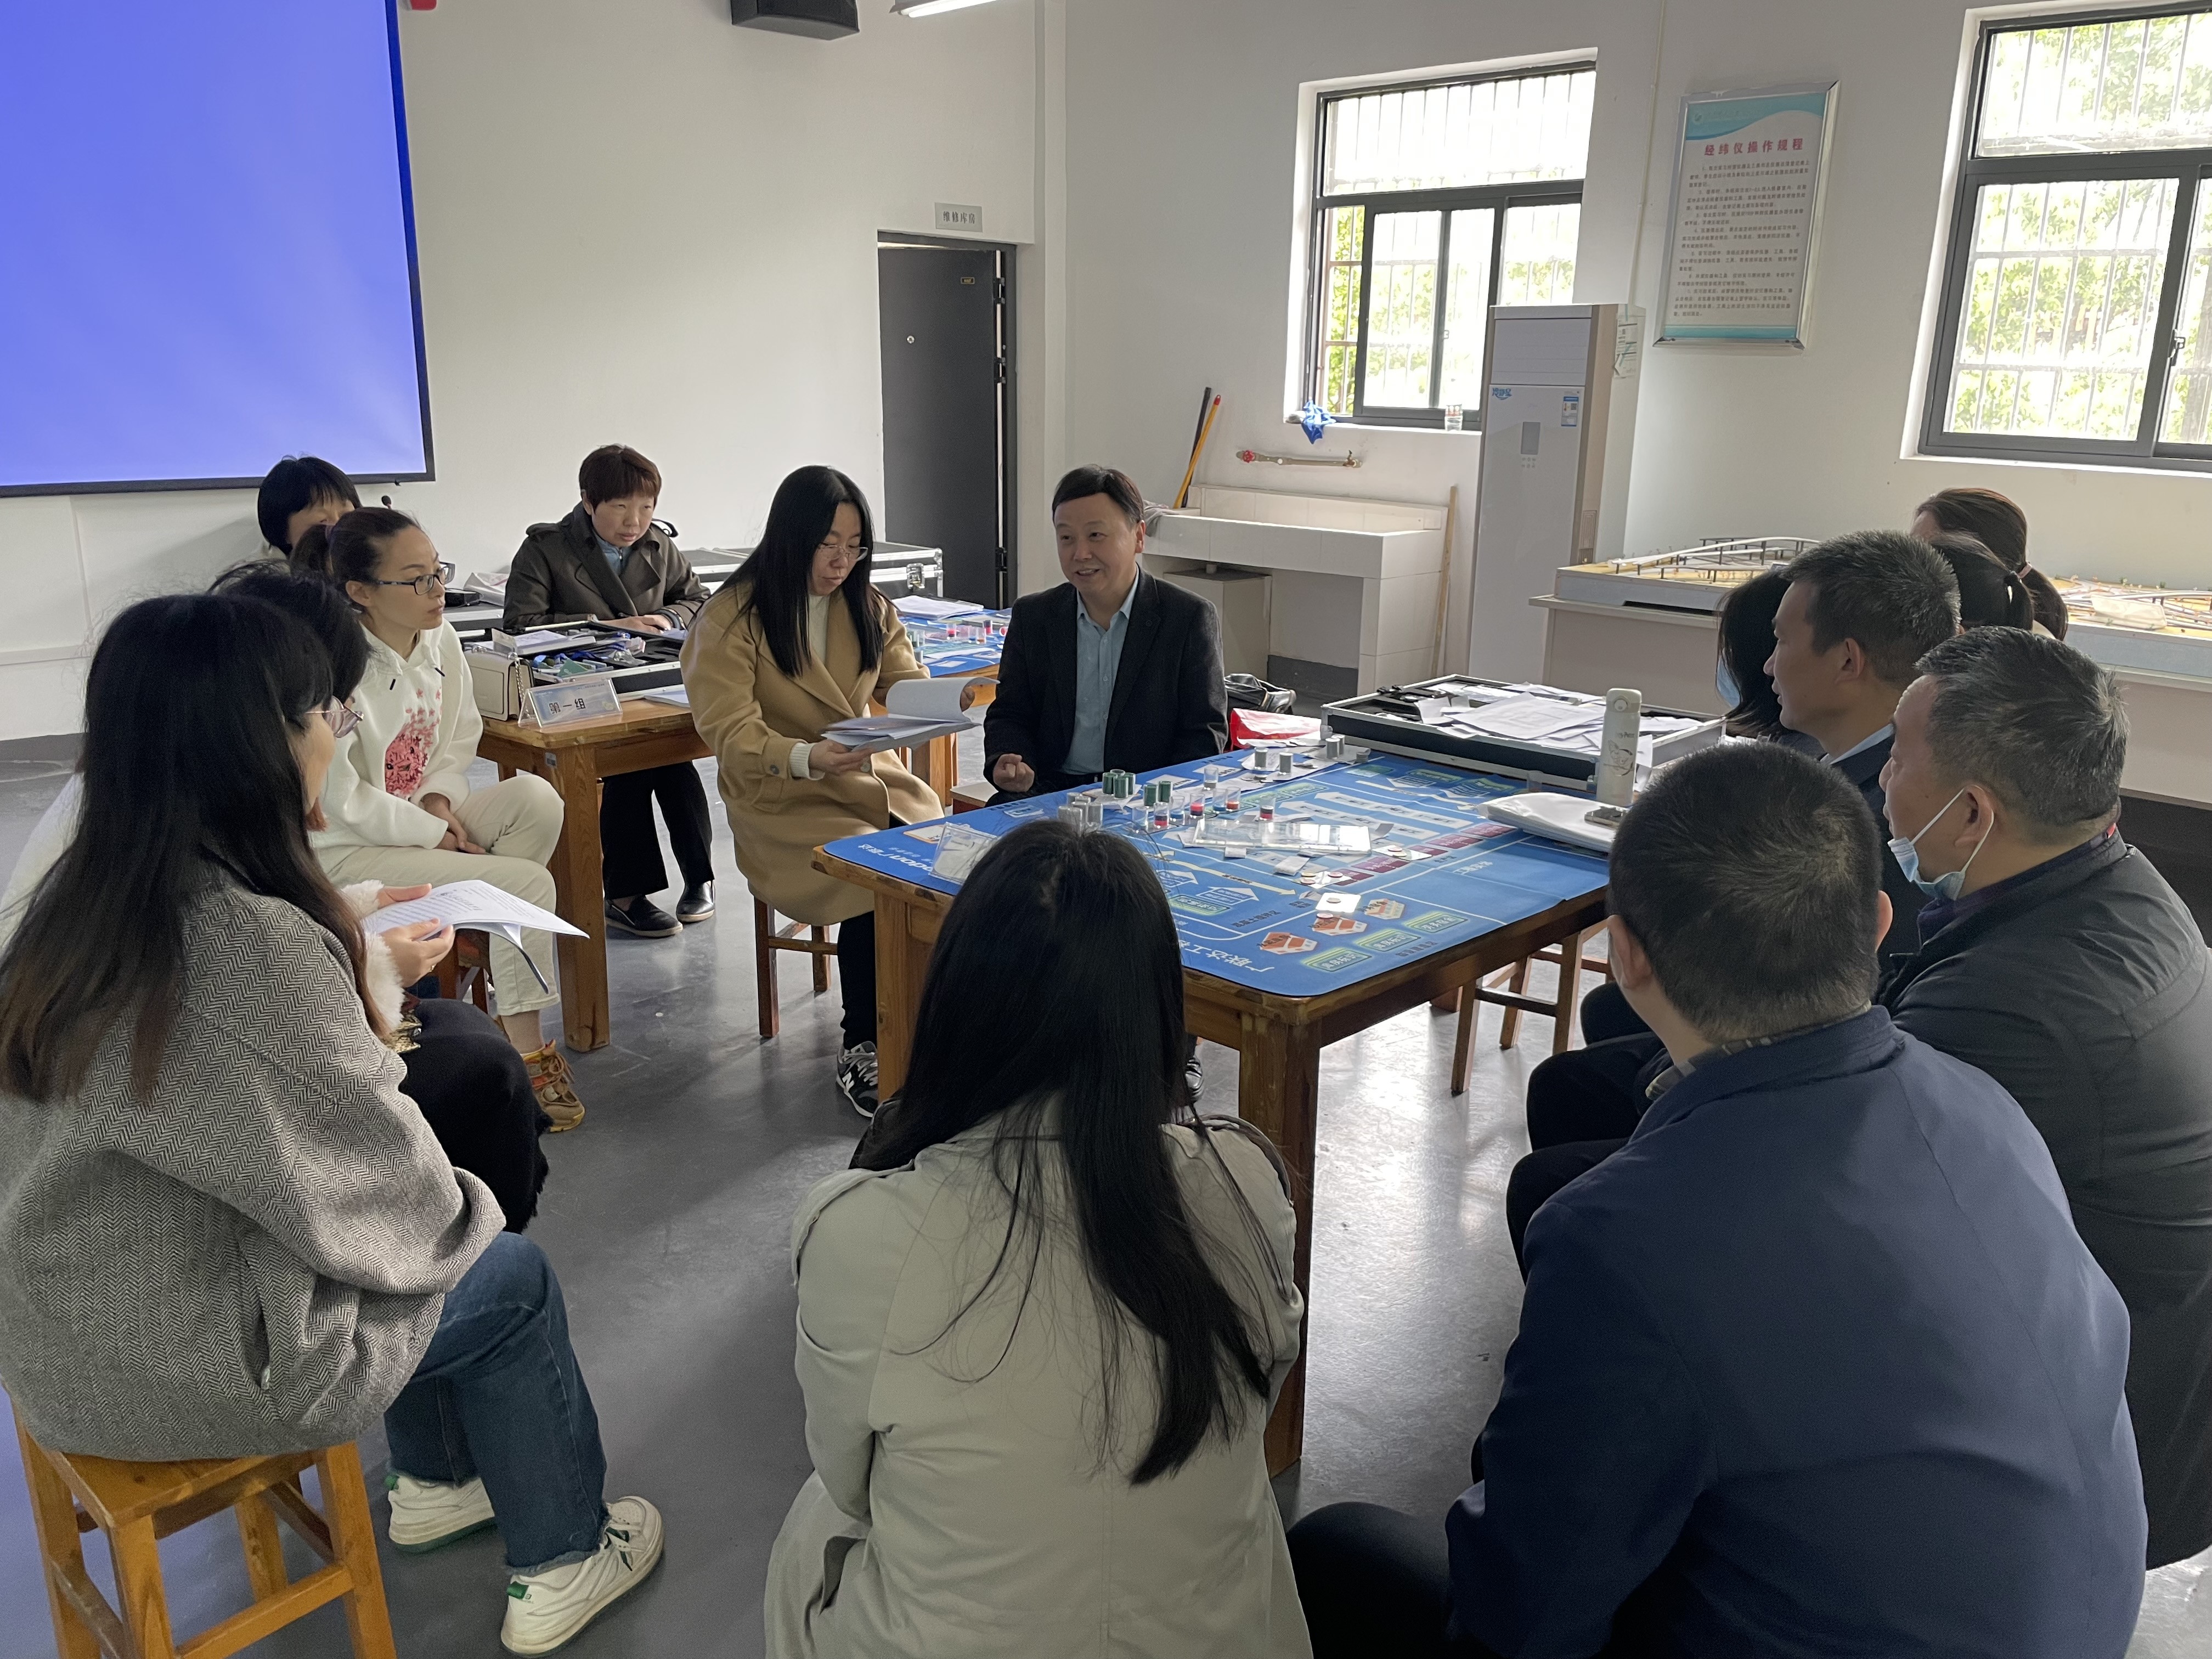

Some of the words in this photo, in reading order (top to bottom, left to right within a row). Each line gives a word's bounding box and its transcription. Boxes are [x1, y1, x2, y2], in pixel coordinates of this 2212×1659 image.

[1704, 138, 1803, 156] 经纬仪操作规程
[943, 211, 975, 224] 维修库房
[549, 698, 586, 714] 第一组
